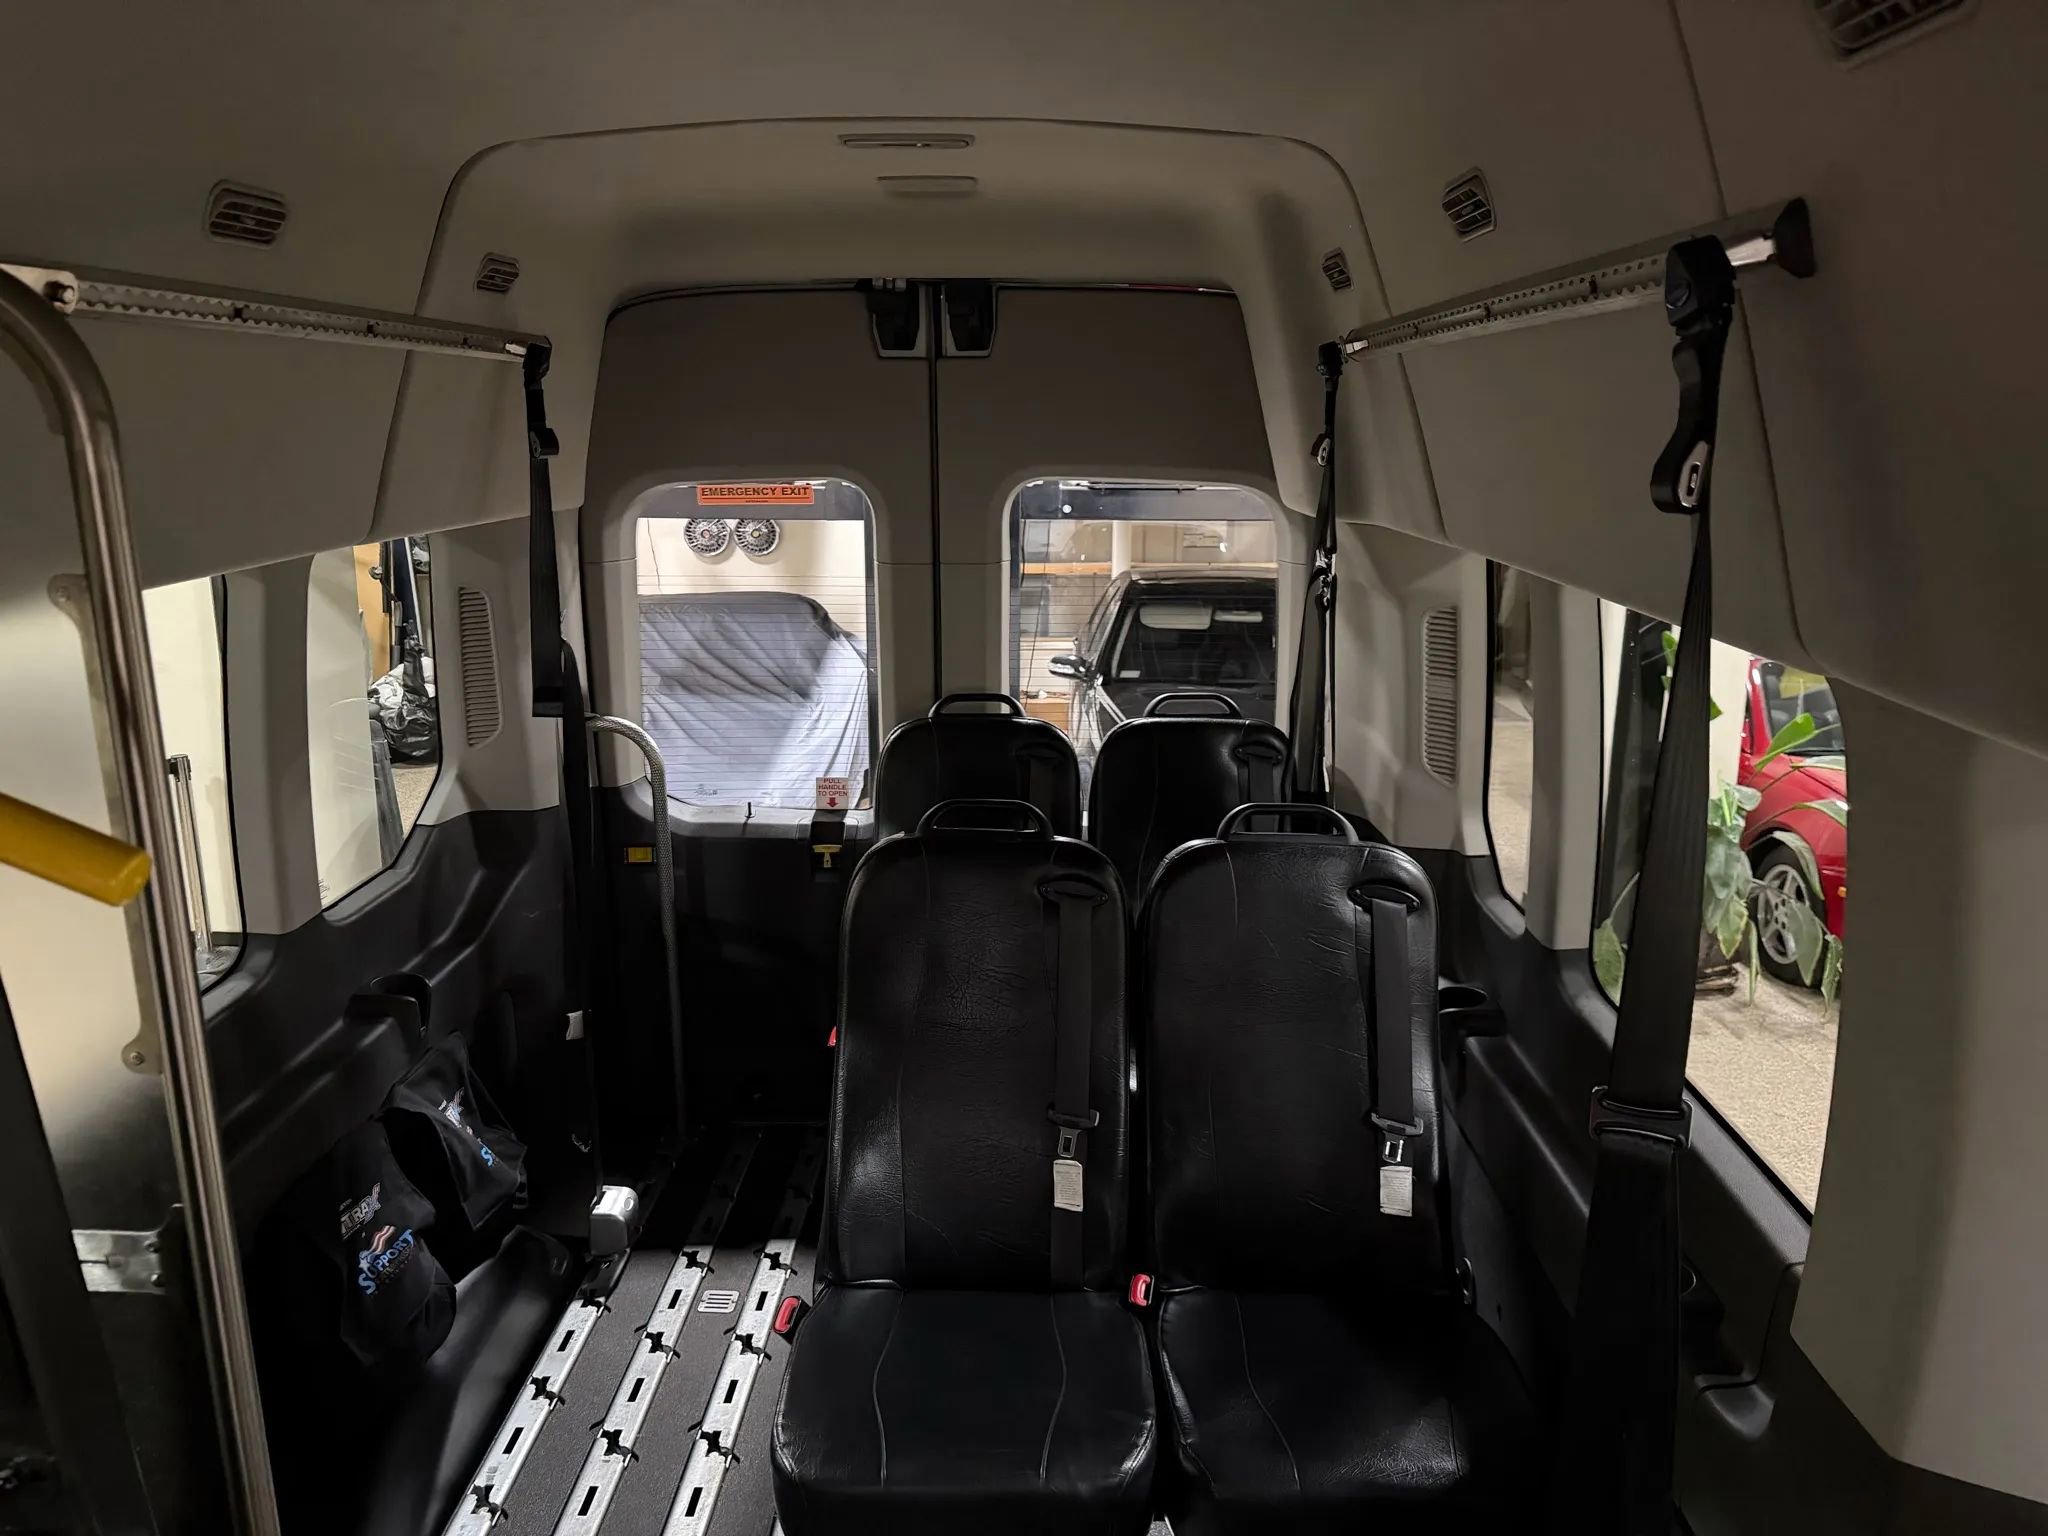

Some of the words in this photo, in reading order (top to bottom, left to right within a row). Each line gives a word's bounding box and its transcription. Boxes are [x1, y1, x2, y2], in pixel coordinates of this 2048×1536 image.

[701, 487, 777, 497] EMERGENCY
[781, 486, 809, 496] EXIT
[358, 1228, 415, 1295] SUPPORT
